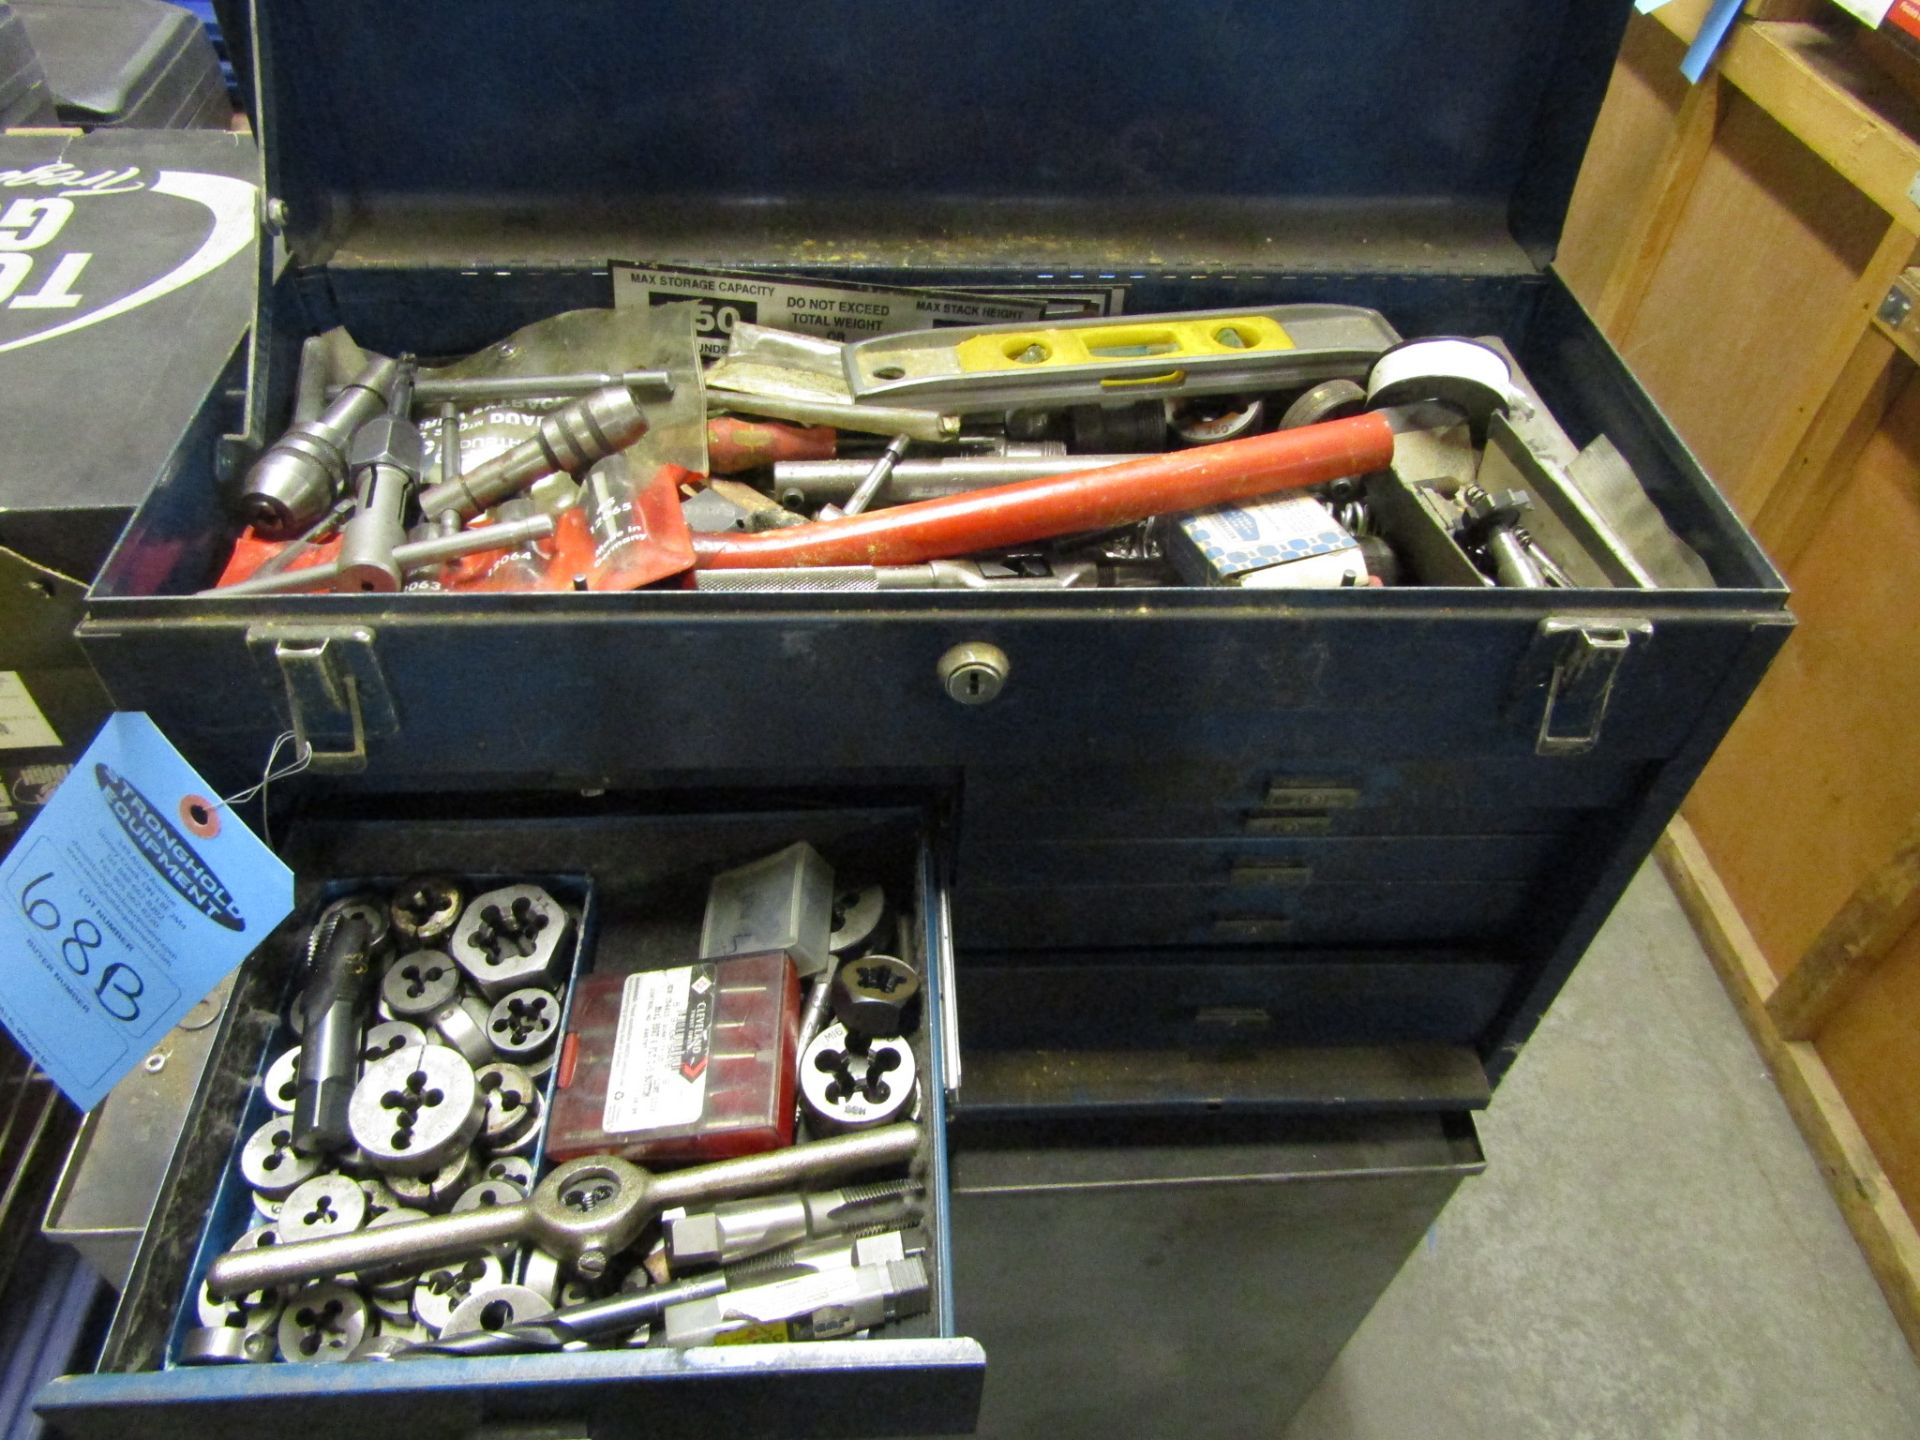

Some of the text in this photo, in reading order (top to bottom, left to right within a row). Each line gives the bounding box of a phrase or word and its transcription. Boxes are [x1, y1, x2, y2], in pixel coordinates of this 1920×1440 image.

[0, 198, 75, 251] G
[630, 273, 776, 297] MAX STORAGE CAPACITY
[694, 304, 741, 334] 50
[786, 297, 890, 317] DO NOT EXCEED
[791, 312, 883, 332] TOTAL WEIGHT
[916, 301, 1025, 320] MAX STACK HEIGHT
[699, 343, 728, 355] UNDS
[627, 525, 642, 534] in
[488, 551, 532, 577] 12064
[593, 533, 648, 568] Germany
[103, 784, 219, 916] EQUIPMENT
[104, 764, 242, 919] STRONGHOLD
[78, 888, 134, 952] LOT NUMBER
[54, 972, 91, 1014] NUMBER
[690, 1002, 707, 1054] CLEVELAND
